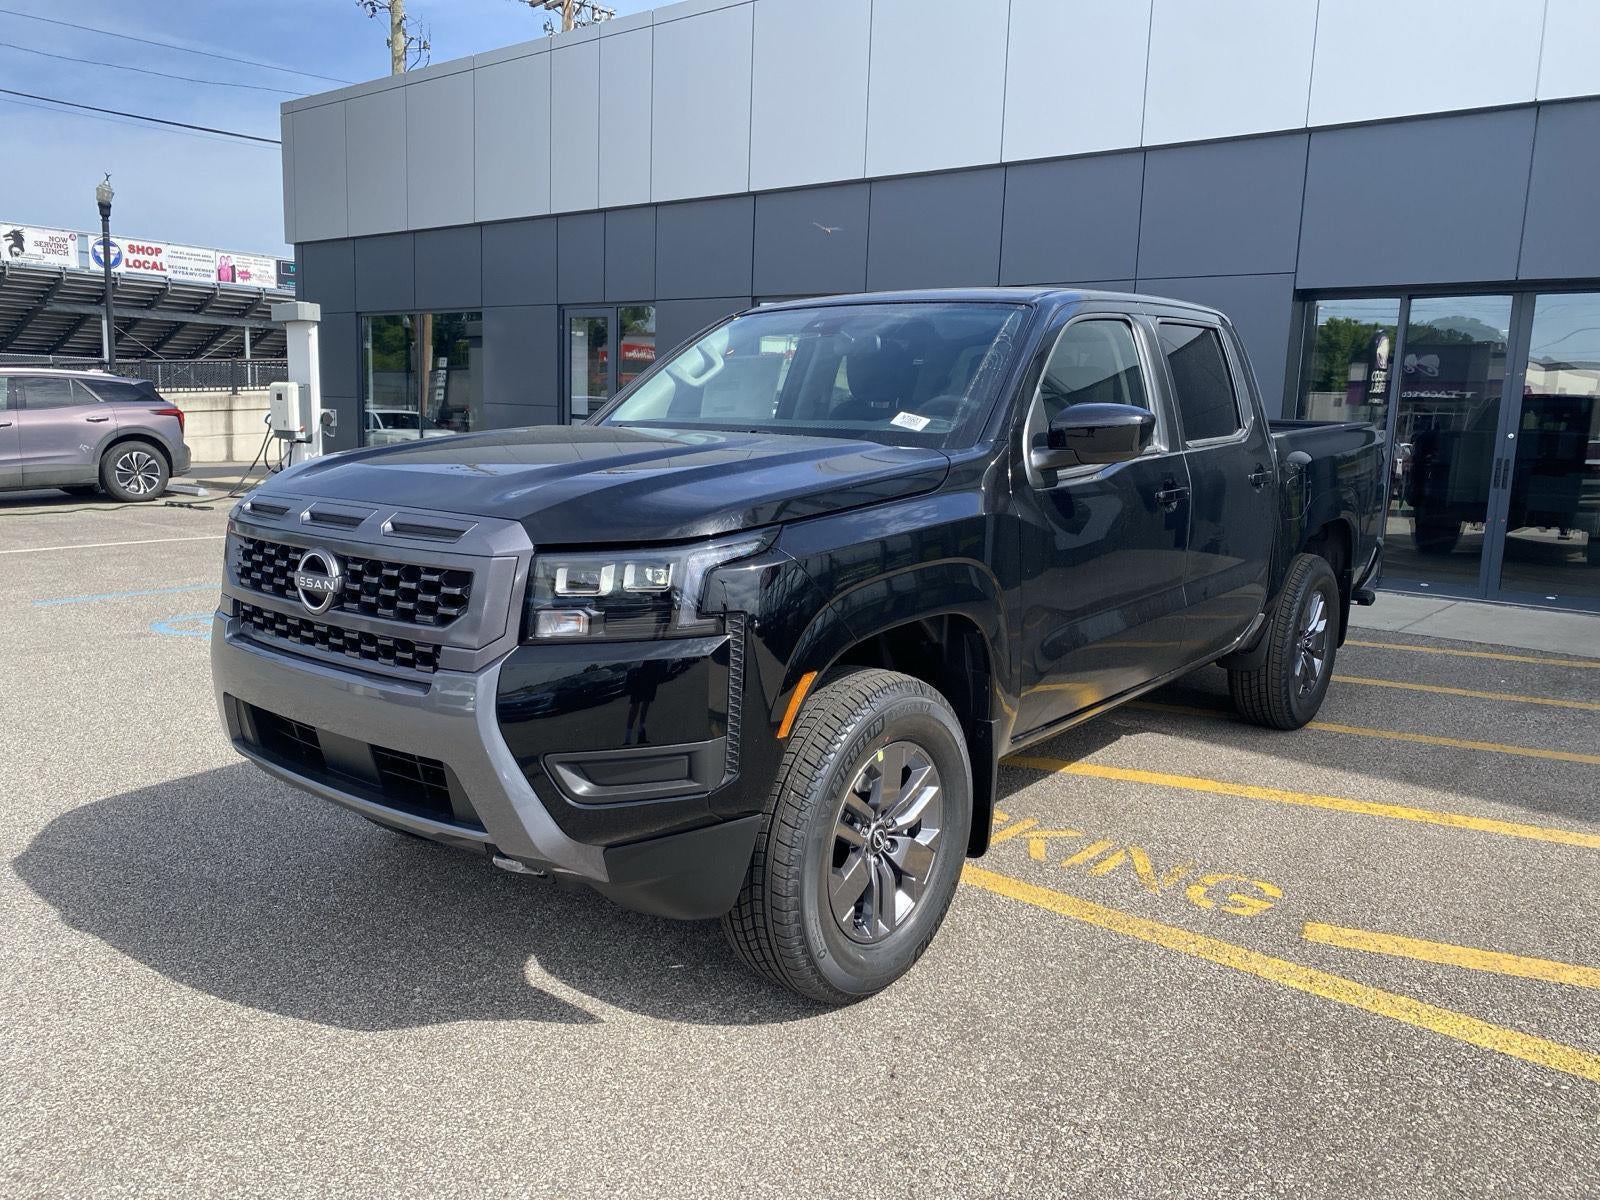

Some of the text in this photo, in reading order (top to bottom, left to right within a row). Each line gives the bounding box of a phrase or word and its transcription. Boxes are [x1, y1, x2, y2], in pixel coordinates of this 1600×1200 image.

[48, 235, 69, 243] NOW
[33, 240, 69, 250] SERVING
[127, 244, 162, 256] SHOP
[42, 247, 69, 257] LUNCH
[125, 258, 167, 272] LOCAL
